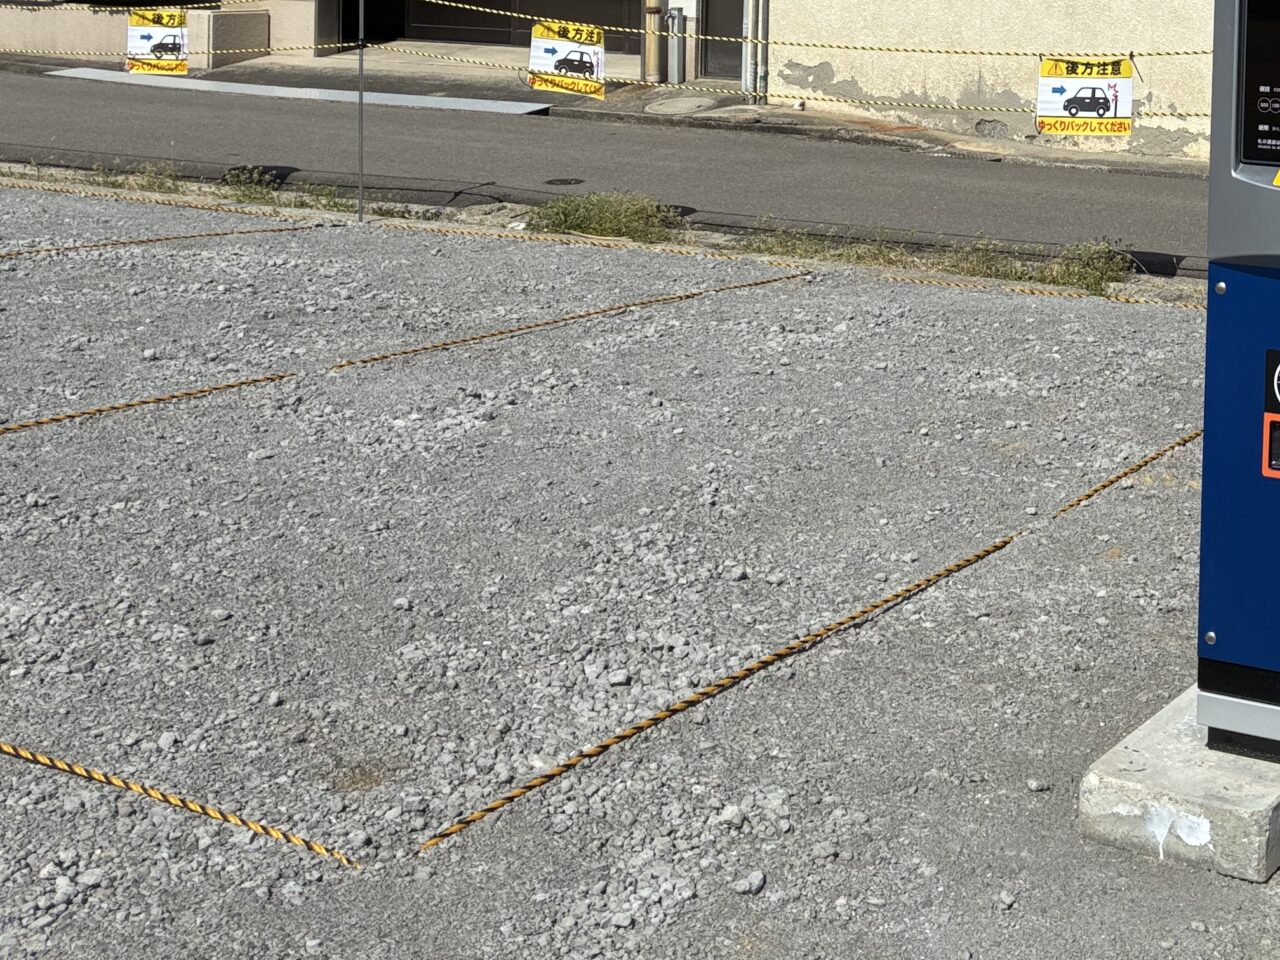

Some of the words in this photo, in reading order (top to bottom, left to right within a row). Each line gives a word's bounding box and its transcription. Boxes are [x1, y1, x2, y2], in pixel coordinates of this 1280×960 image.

[1065, 60, 1122, 77] 後方注意
[1039, 120, 1131, 133] ゆっくりバックしてください
